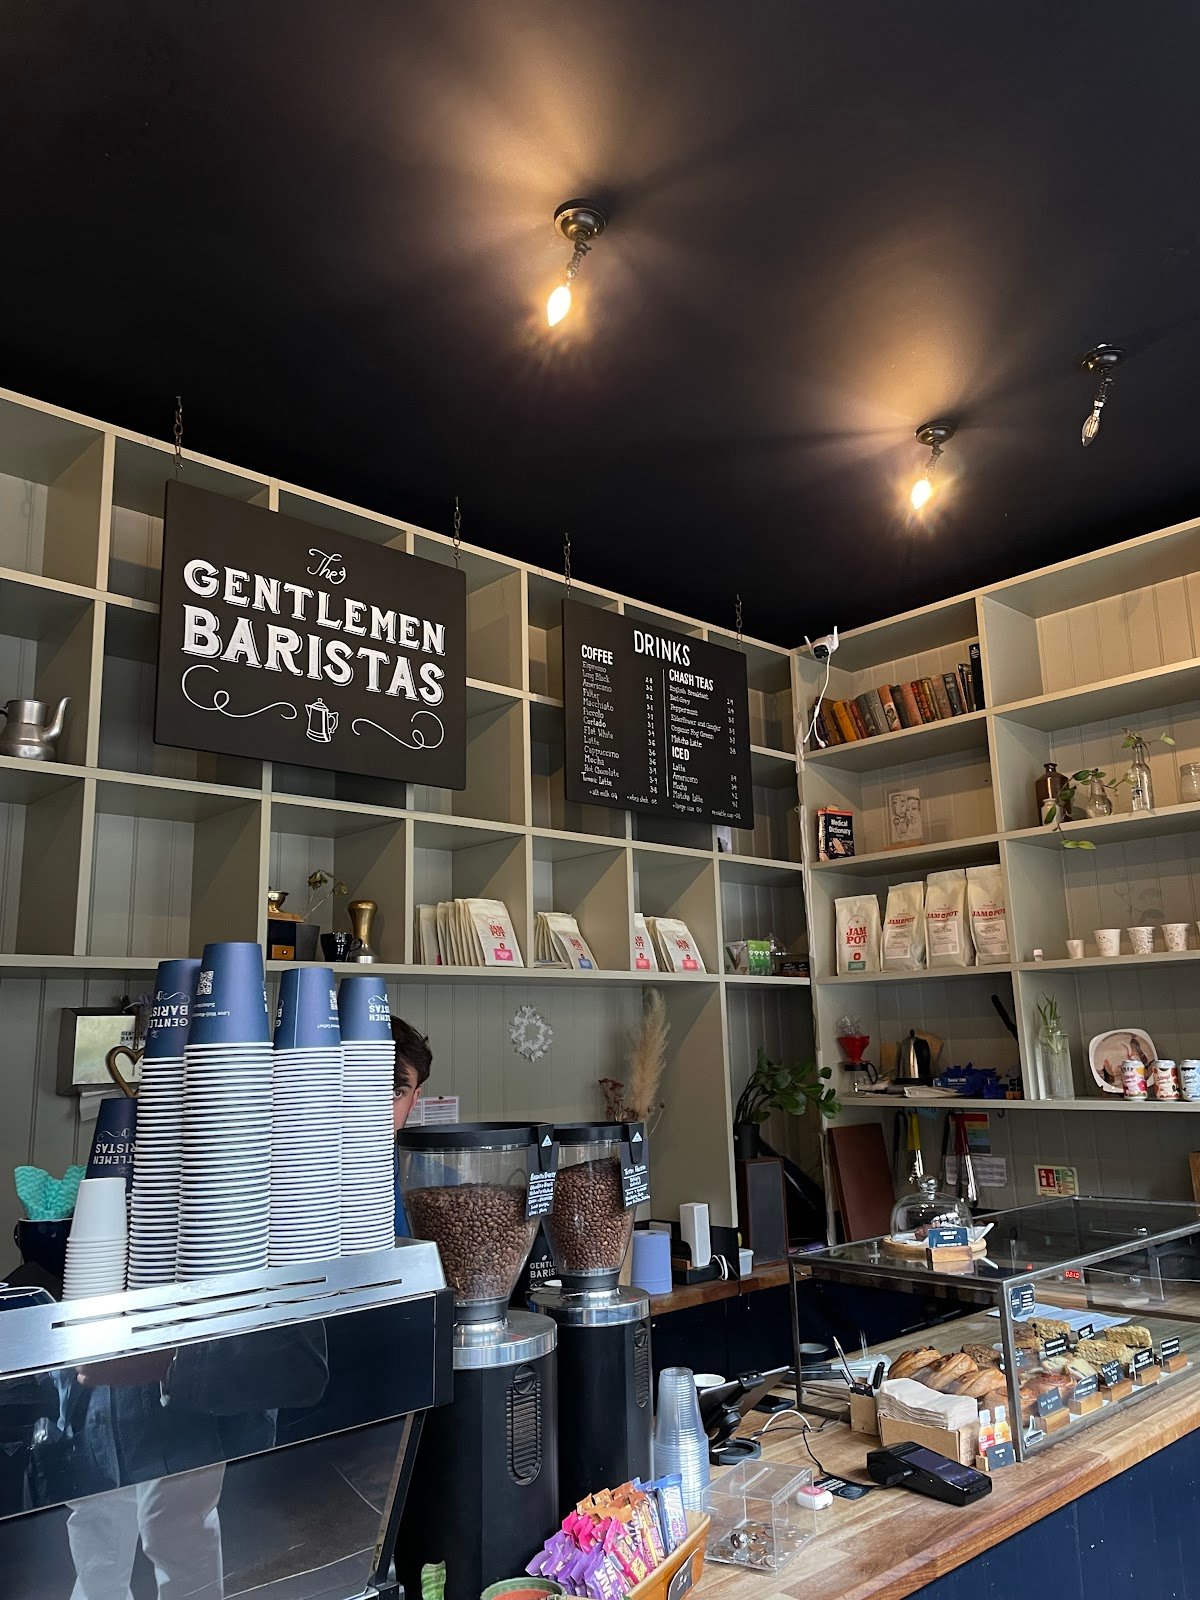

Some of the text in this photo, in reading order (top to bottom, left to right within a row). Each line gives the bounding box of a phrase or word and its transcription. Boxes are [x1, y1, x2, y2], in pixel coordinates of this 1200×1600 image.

[307, 549, 346, 584] The
[183, 559, 446, 656] GENTLEMEN
[634, 630, 690, 666] DRINKS
[181, 604, 444, 707] BARISTAS
[582, 645, 613, 665] COFFEE
[582, 661, 606, 673] Espresso
[595, 673, 610, 683] Black
[669, 669, 714, 691] CHASH TEAS
[583, 679, 612, 692] Americano
[583, 688, 599, 699] Filter
[583, 697, 614, 711] Macchiato
[583, 707, 604, 719] Piccolo
[583, 716, 606, 728] Cortado
[584, 726, 596, 735] Flat
[598, 728, 613, 739] White
[584, 735, 599, 746] Latte
[671, 735, 689, 745] Matcha
[584, 745, 619, 758] Cappuccino
[672, 746, 689, 761] ICED
[585, 754, 604, 765] Mocha
[584, 764, 593, 772] Hot
[594, 766, 619, 777] Chocolate
[673, 763, 686, 772] Latte
[599, 776, 612, 786] Latte
[673, 772, 698, 784] Americano
[673, 781, 687, 791] Mocha
[831, 819, 848, 827] Medical
[829, 826, 851, 836] Dictionary
[489, 925, 505, 934] JAM
[847, 927, 867, 936] JAM
[846, 935, 867, 944] POT
[150, 1005, 188, 1017] BARIS
